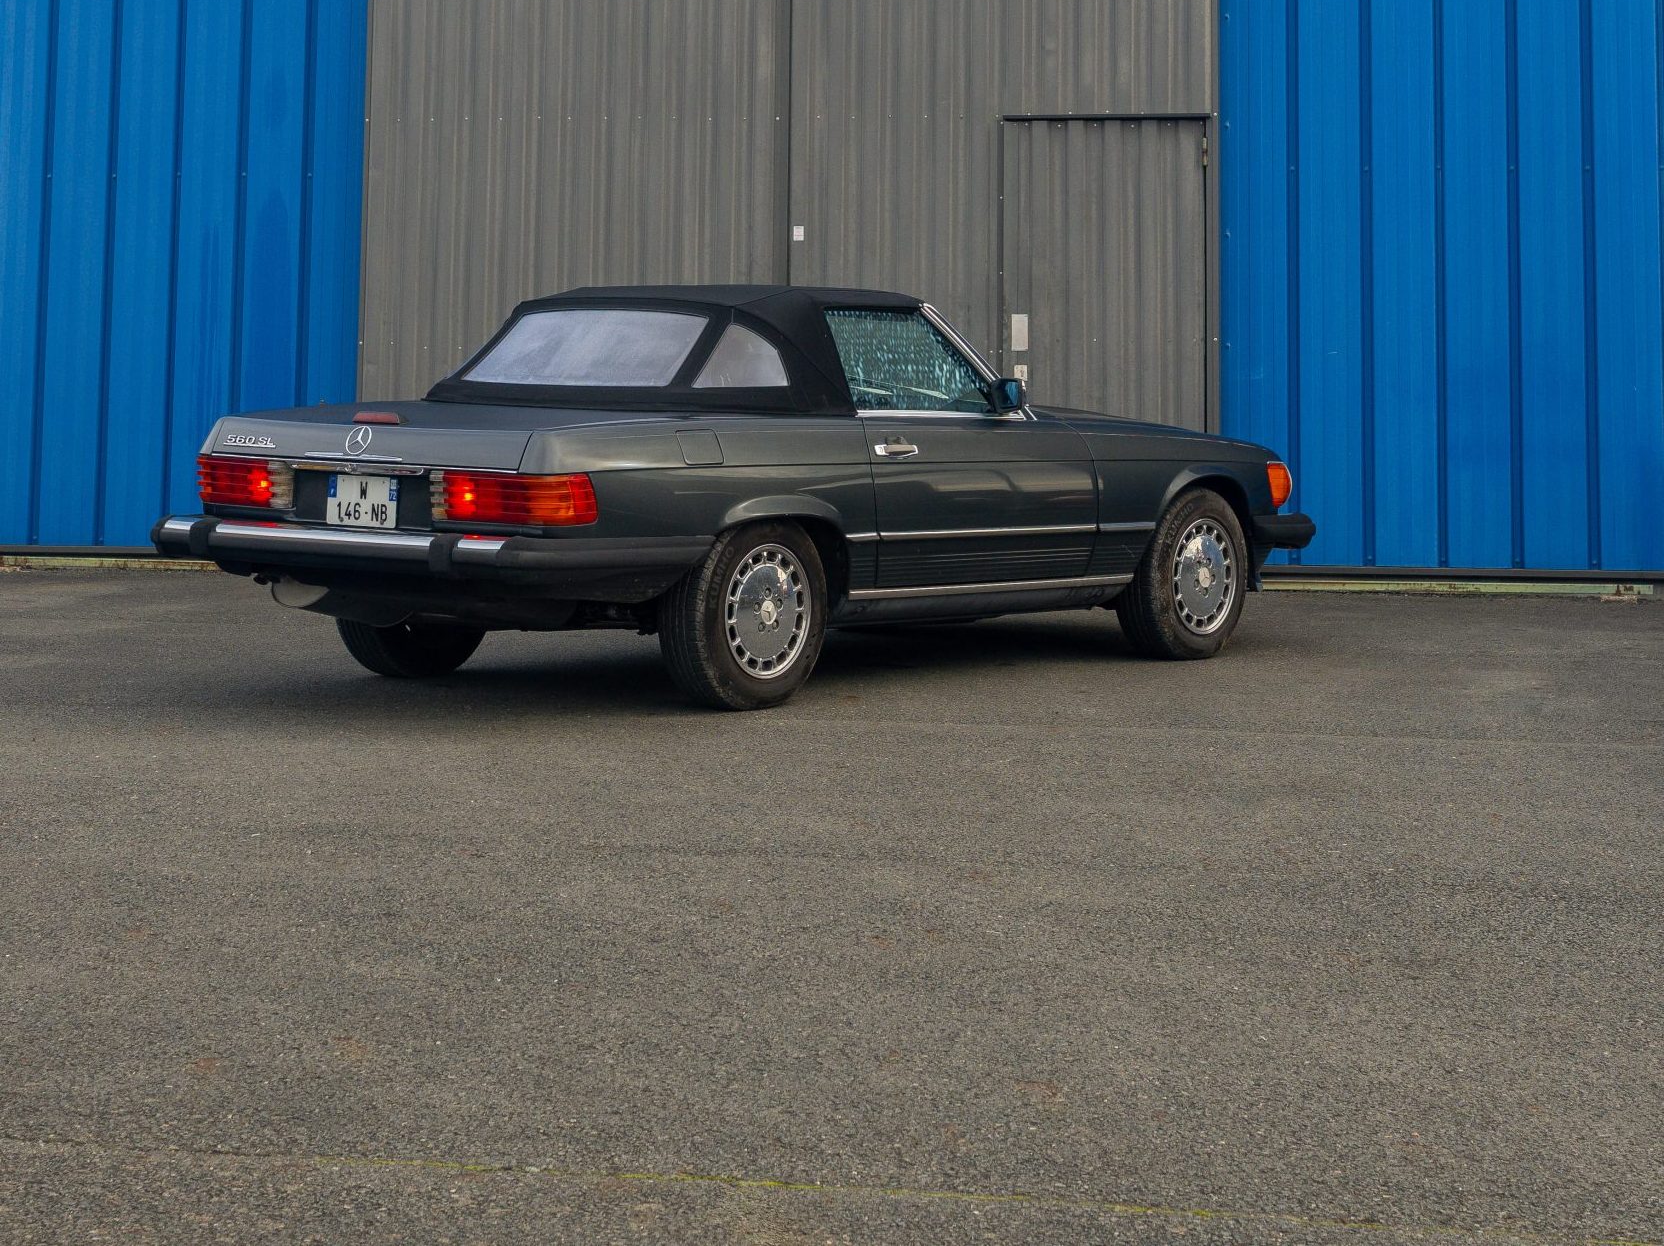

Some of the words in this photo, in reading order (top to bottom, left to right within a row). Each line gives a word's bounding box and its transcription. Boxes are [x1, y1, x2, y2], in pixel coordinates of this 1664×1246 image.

[226, 434, 255, 445] 560
[257, 436, 275, 446] SL
[359, 480, 369, 500] W
[389, 490, 397, 500] 72
